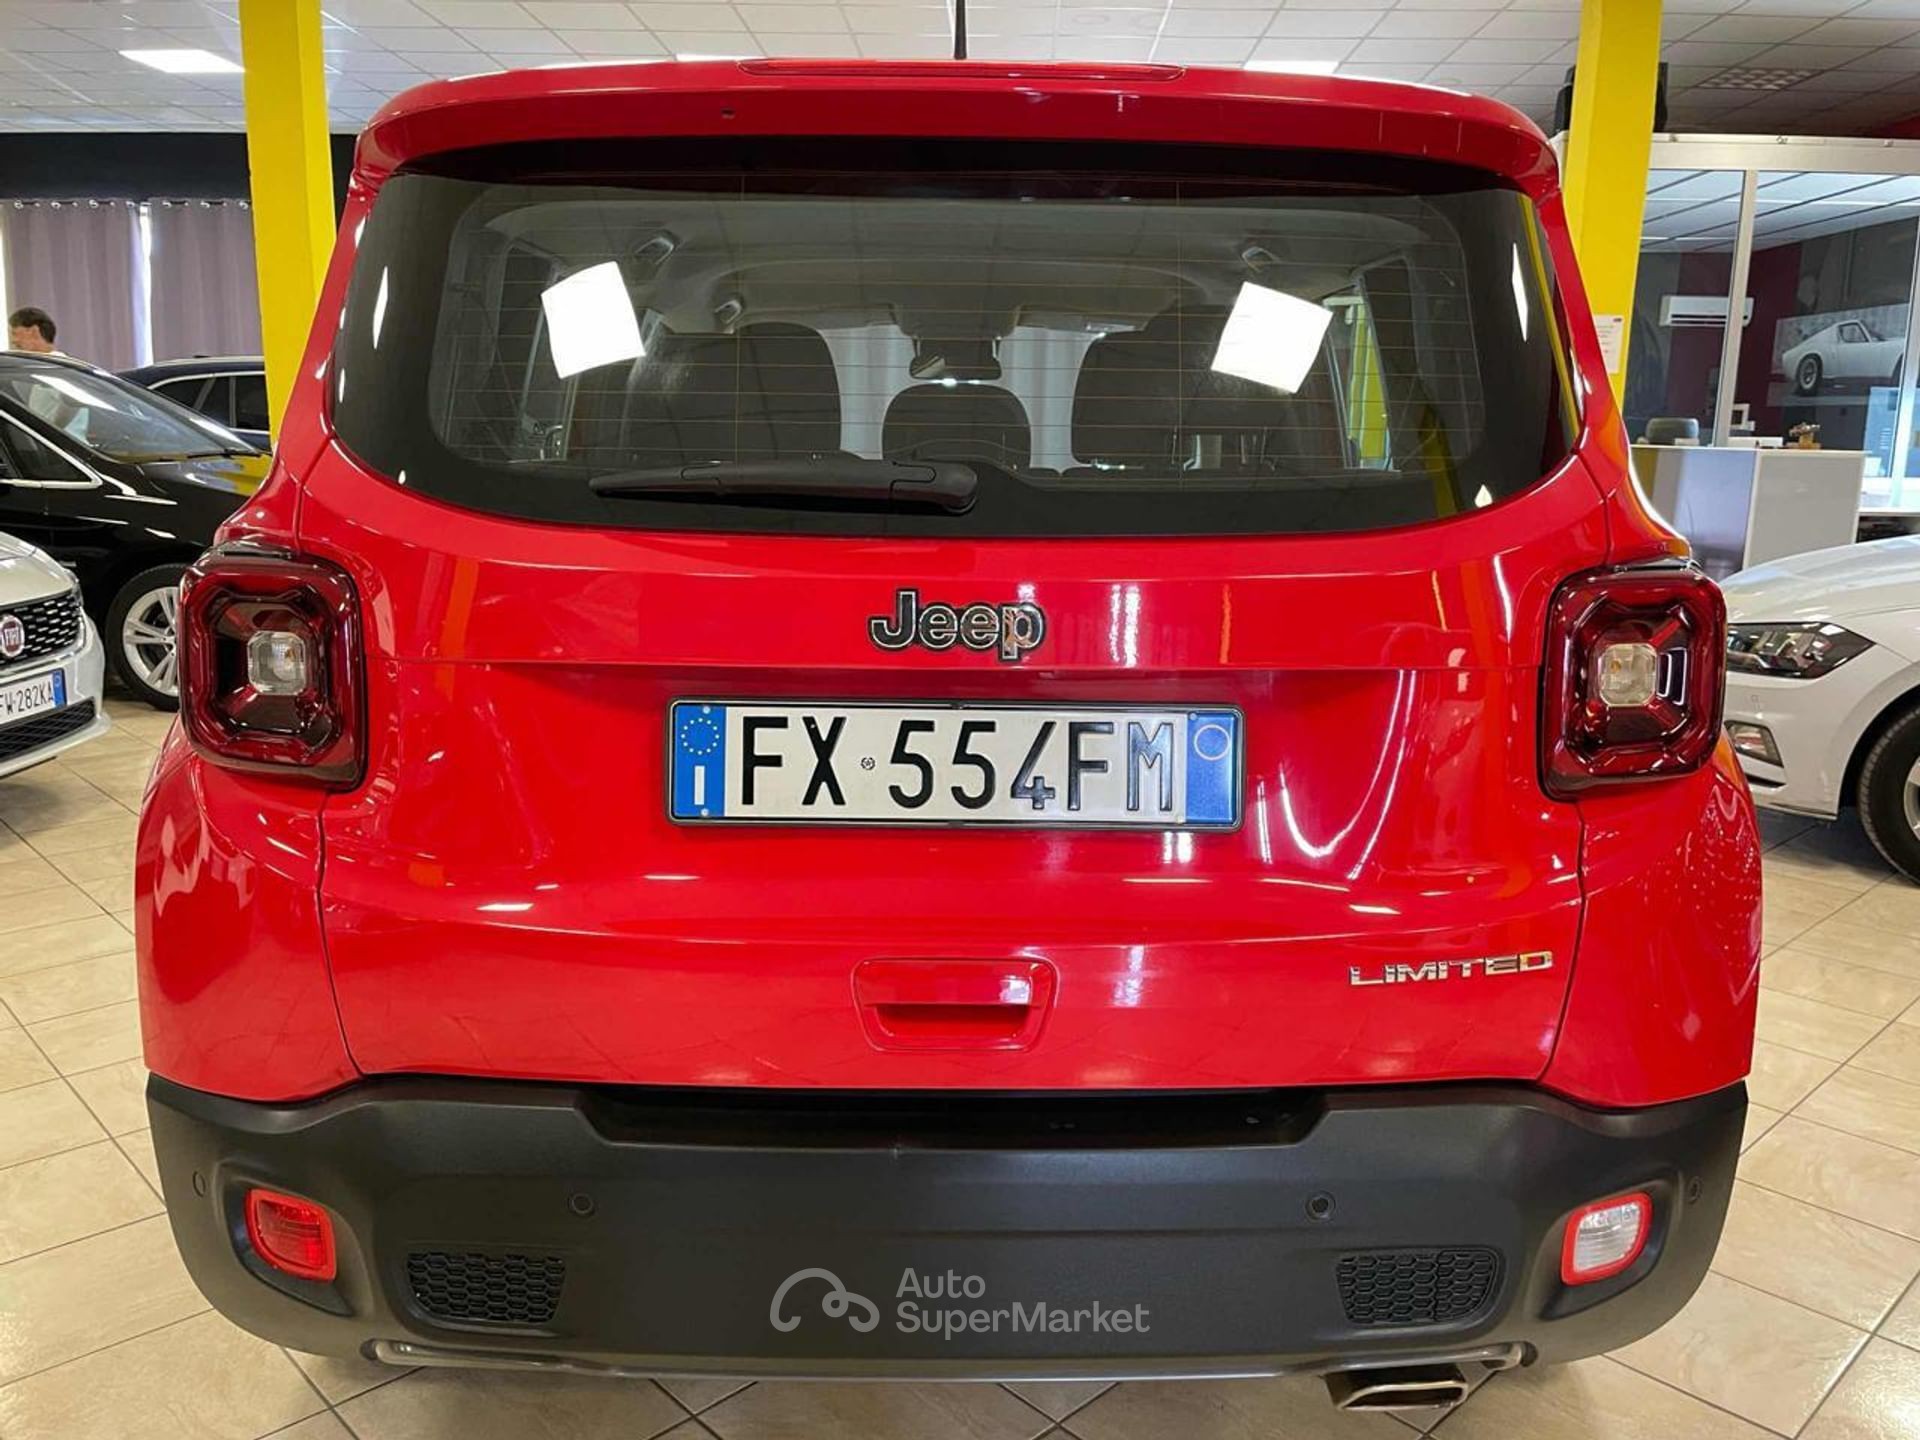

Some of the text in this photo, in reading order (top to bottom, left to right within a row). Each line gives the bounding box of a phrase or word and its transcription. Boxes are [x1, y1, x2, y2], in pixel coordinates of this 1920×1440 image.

[868, 588, 1046, 662] Jeep
[741, 716, 1174, 811] FX 554FM
[1350, 951, 1553, 986] LIMITED
